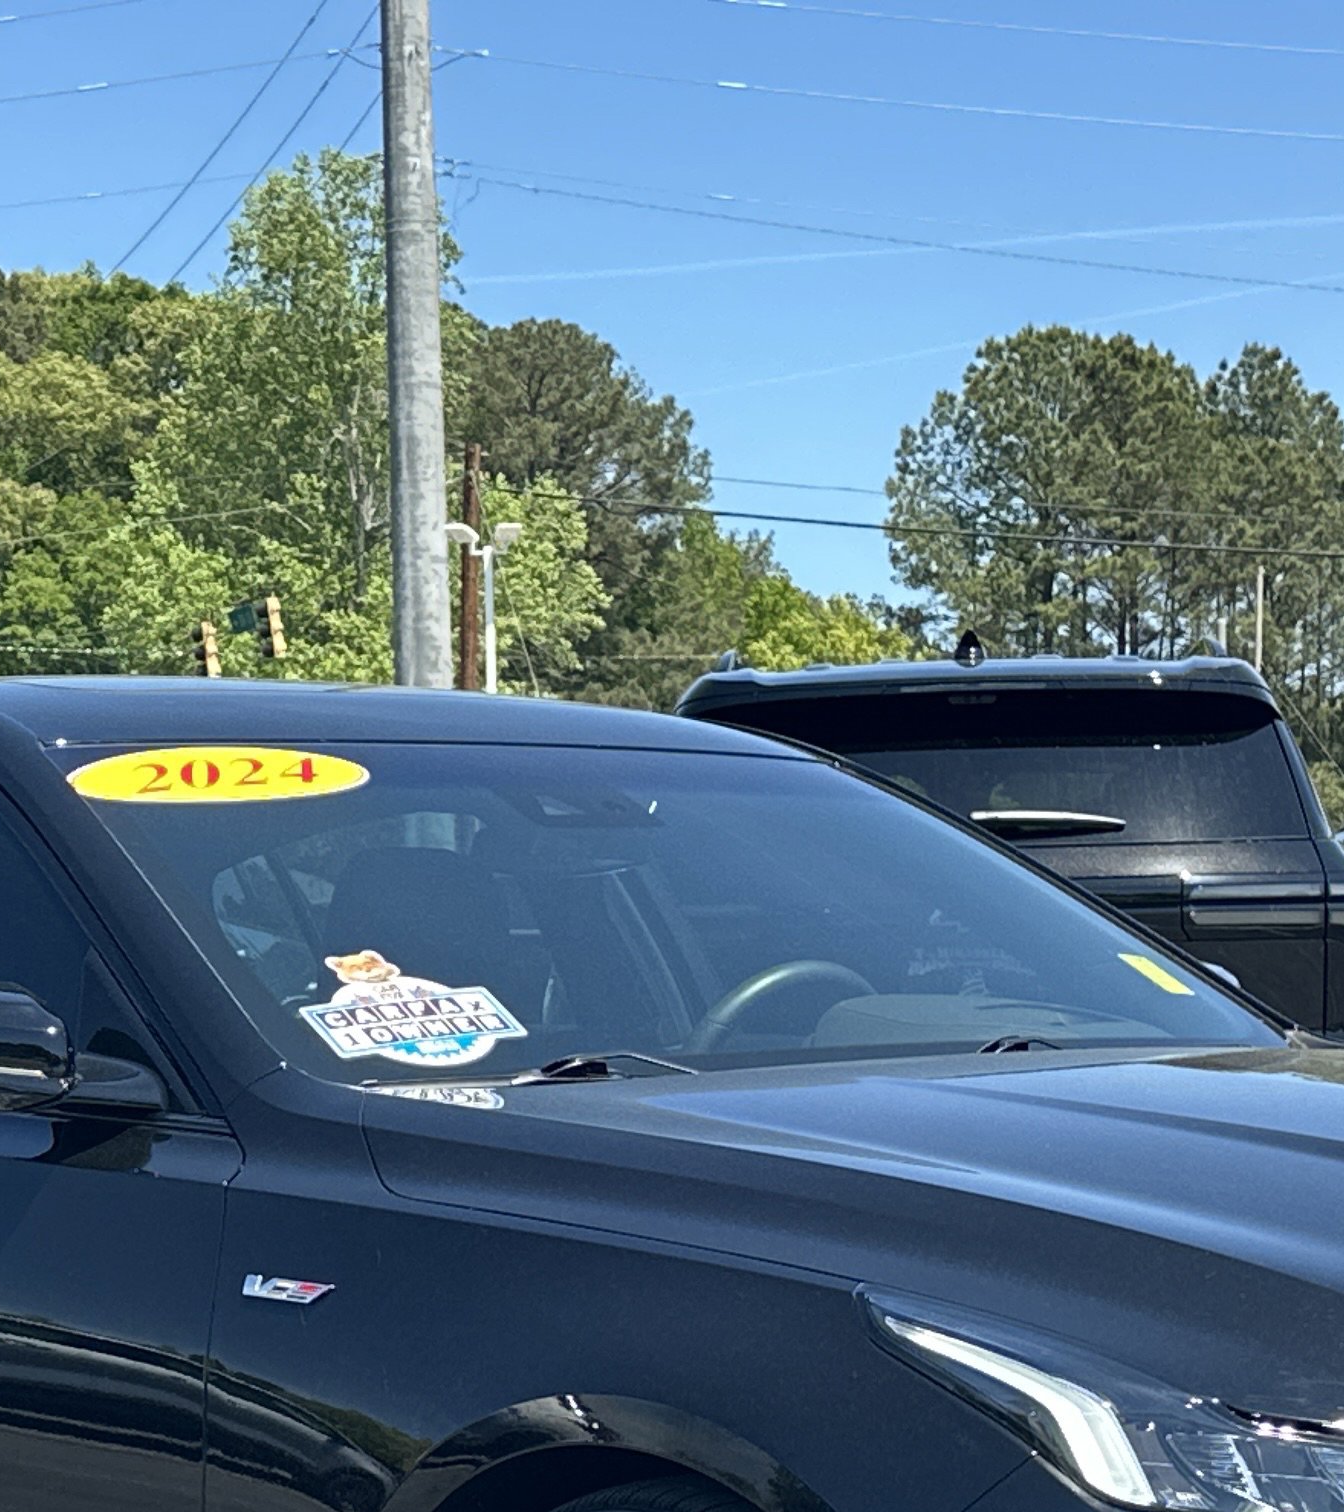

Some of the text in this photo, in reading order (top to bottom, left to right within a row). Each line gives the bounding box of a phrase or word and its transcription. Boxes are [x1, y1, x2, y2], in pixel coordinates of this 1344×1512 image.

[133, 757, 319, 794] 2024
[320, 997, 486, 1028] CARFAX
[344, 1013, 507, 1047] 1 OWNER
